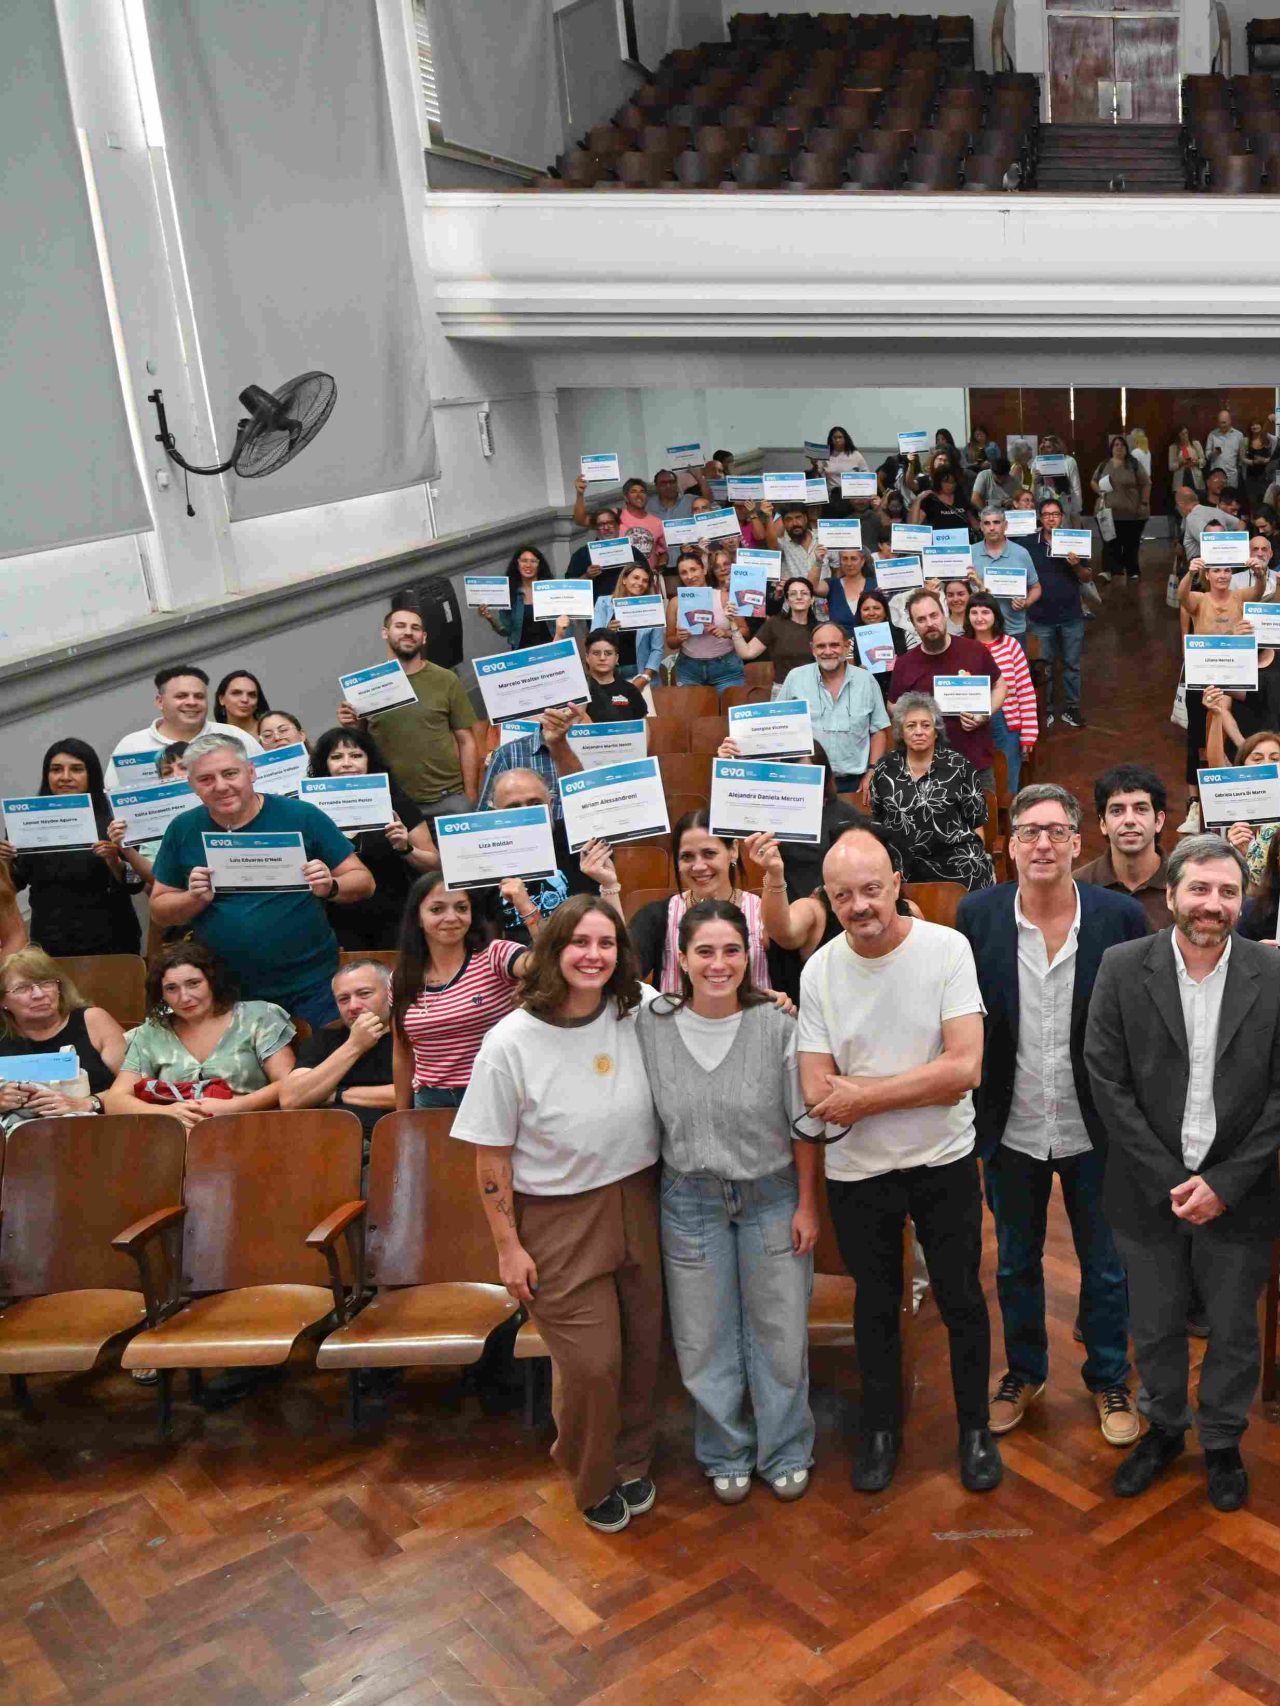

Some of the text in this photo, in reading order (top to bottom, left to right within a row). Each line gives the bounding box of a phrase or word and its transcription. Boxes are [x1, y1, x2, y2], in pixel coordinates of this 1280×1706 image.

[1189, 639, 1205, 648] eva
[482, 662, 507, 673] eva
[344, 678, 360, 688] eva
[498, 681, 521, 690] Marcelo
[521, 676, 541, 685] Walter
[734, 709, 753, 719] eva
[505, 722, 521, 731] eva
[571, 728, 591, 737] eva
[118, 757, 137, 766] eva
[720, 766, 745, 778] eva
[1203, 774, 1223, 783] eva
[306, 782, 327, 792] eva
[565, 780, 586, 793] eva
[116, 795, 138, 805] eva
[728, 791, 757, 800] Alejandra
[757, 793, 780, 801] Daniela
[581, 793, 637, 810] Miriam Alessandroni
[8, 803, 31, 812] eva
[444, 821, 471, 833] eva
[210, 839, 233, 847] eva
